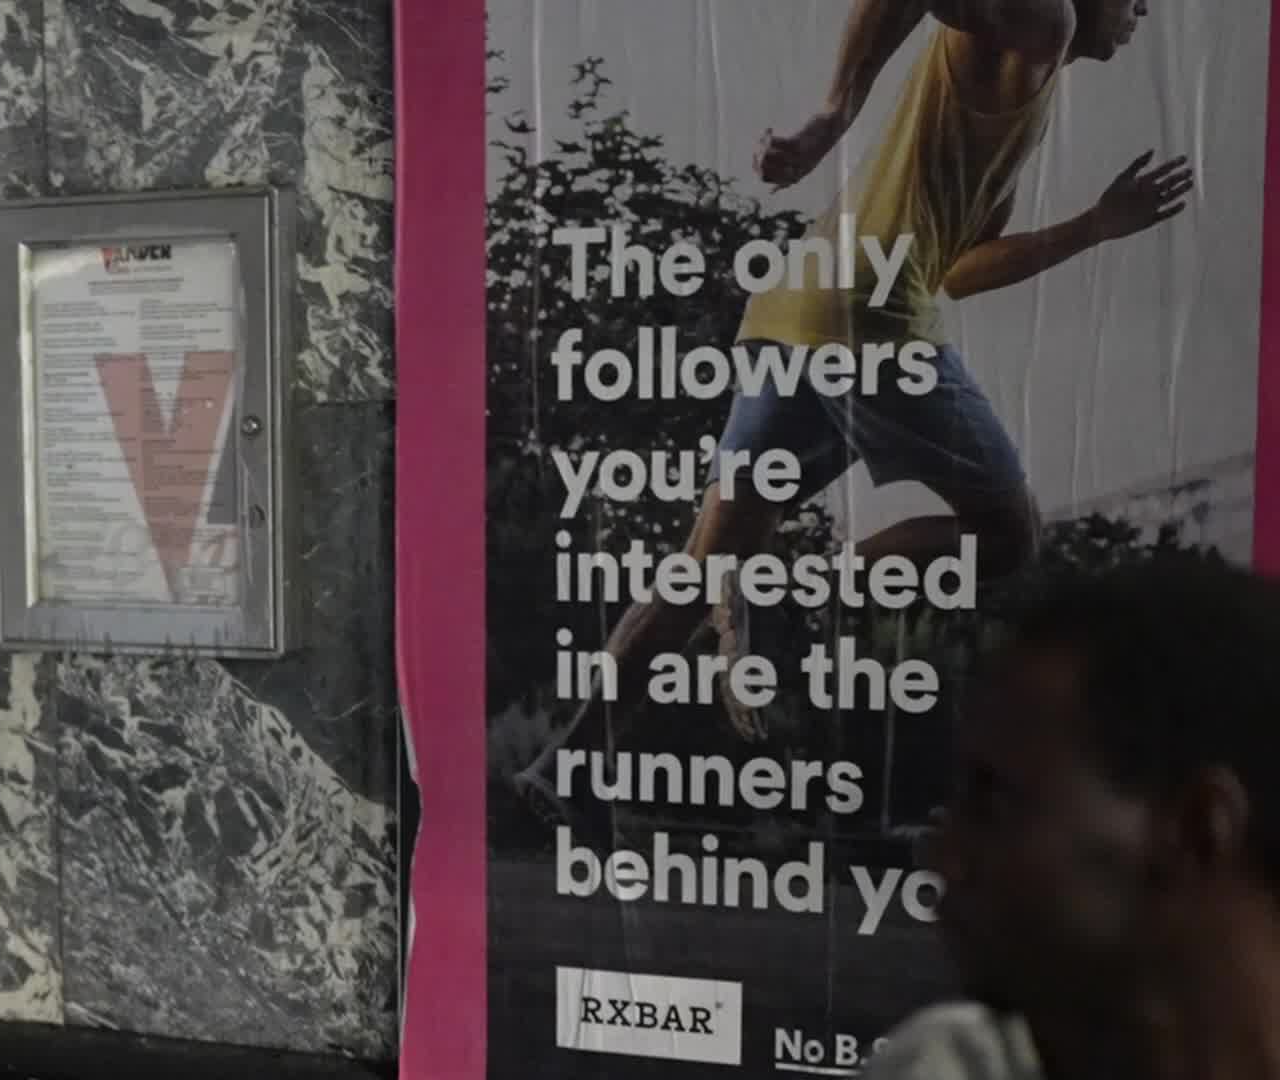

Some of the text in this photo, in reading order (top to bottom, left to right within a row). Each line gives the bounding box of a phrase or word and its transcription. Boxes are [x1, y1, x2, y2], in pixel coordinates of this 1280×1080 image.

[552, 212, 914, 307] The only
[551, 327, 939, 401] followers
[552, 436, 802, 519] you're
[555, 530, 977, 610] interested
[556, 628, 941, 713] in are the
[556, 745, 864, 814] runners
[556, 825, 947, 936] behind yo
[581, 996, 715, 1035] RXBAR
[774, 1027, 825, 1064] No
